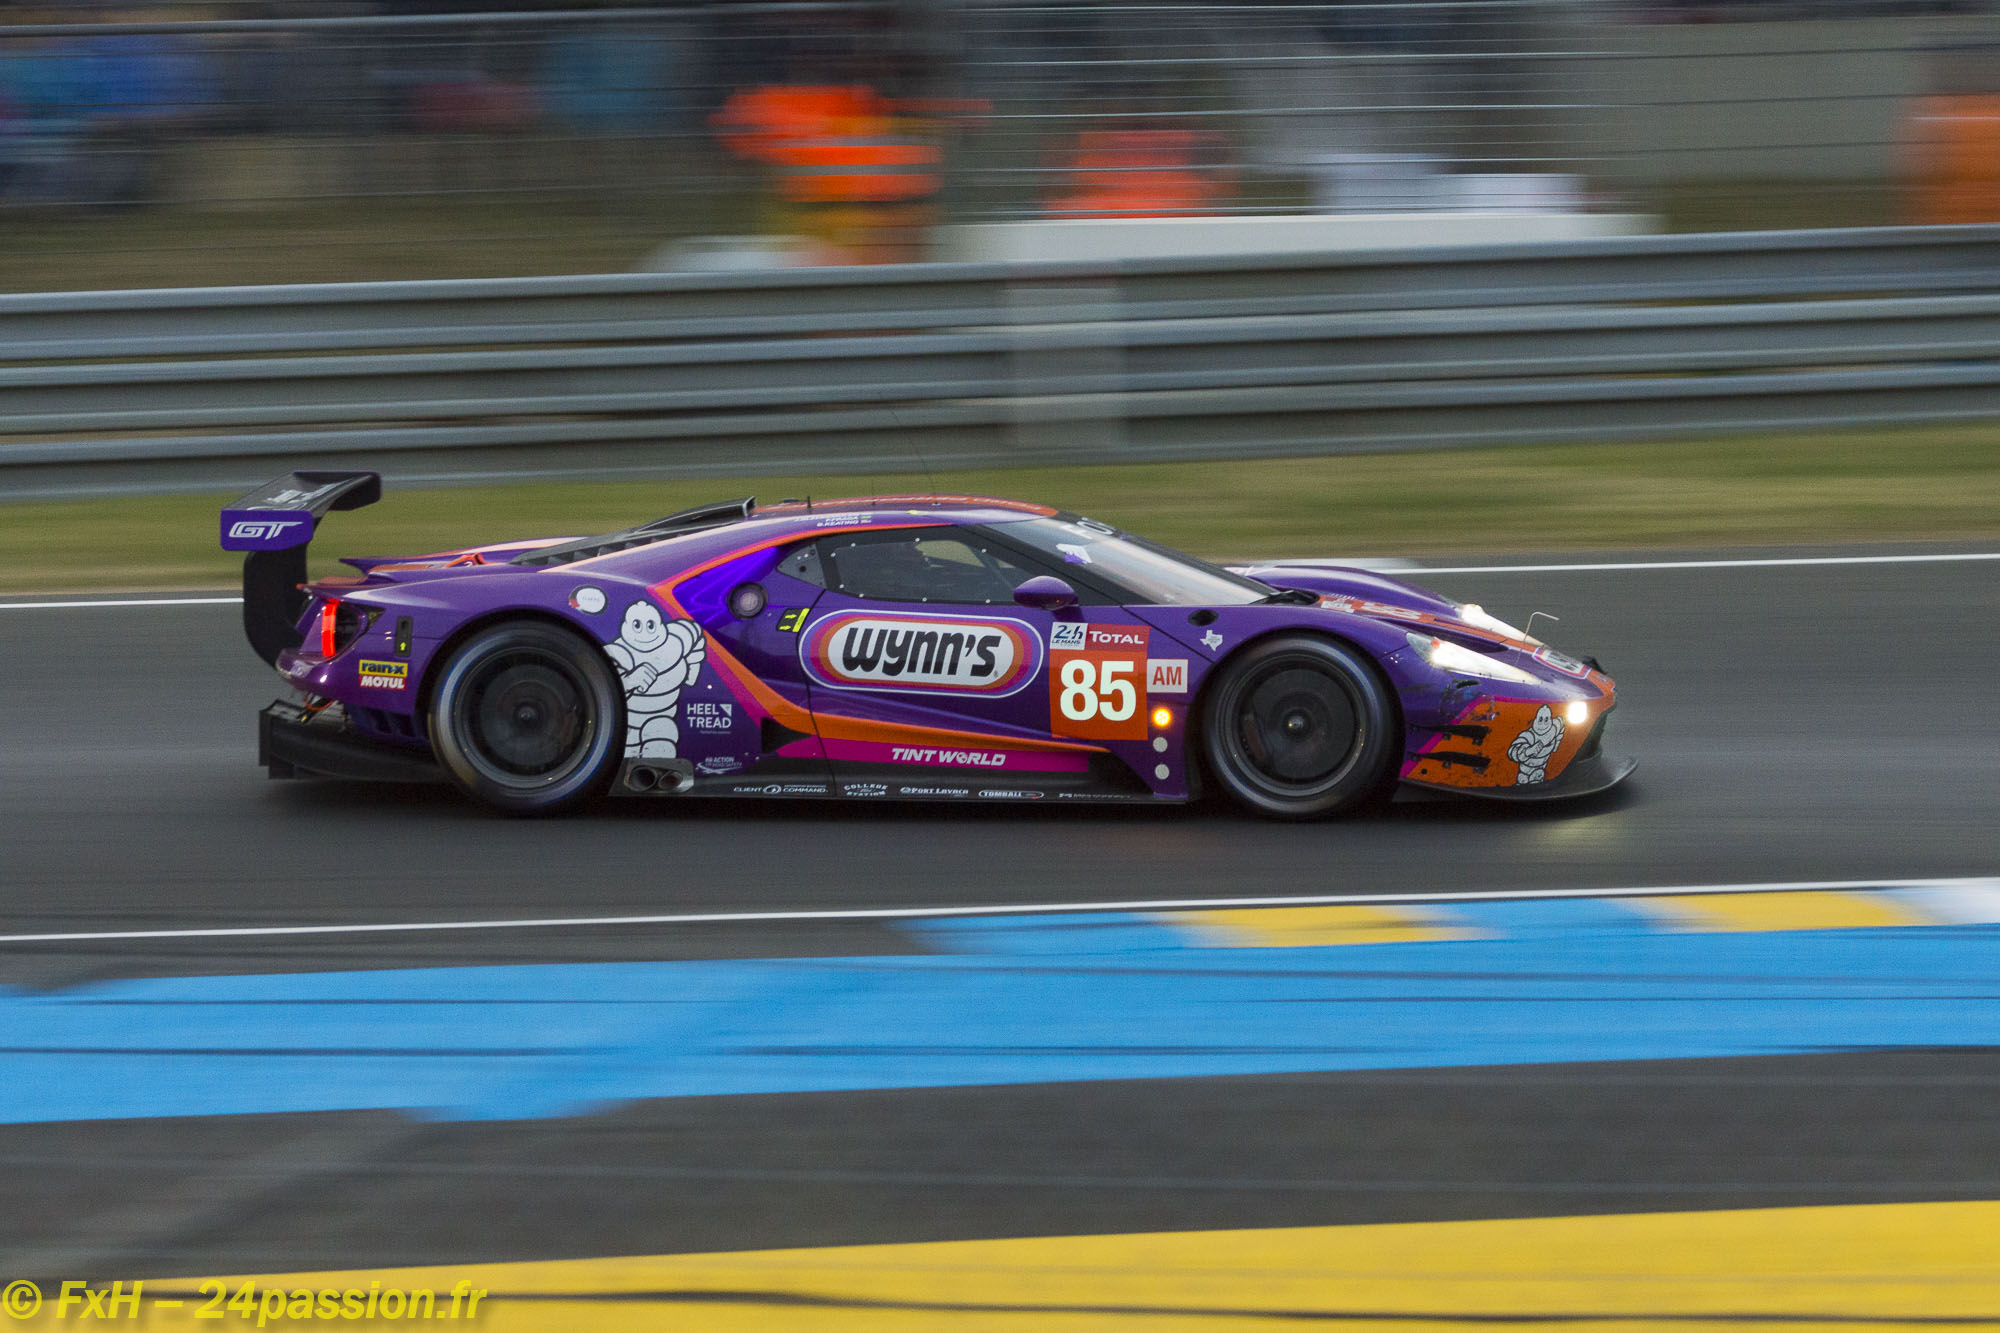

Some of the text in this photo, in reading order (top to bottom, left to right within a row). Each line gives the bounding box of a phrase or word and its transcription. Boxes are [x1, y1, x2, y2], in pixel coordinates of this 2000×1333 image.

[228, 521, 304, 540] GT
[1054, 624, 1084, 639] 24h
[1088, 630, 1145, 644] TOTAL
[360, 675, 405, 689] MOTUL
[1152, 666, 1182, 686] AM
[1060, 659, 1137, 722] 85
[687, 703, 720, 715] HEEL
[687, 716, 732, 728] TREAD
[891, 748, 1006, 767] TINT WORLD
